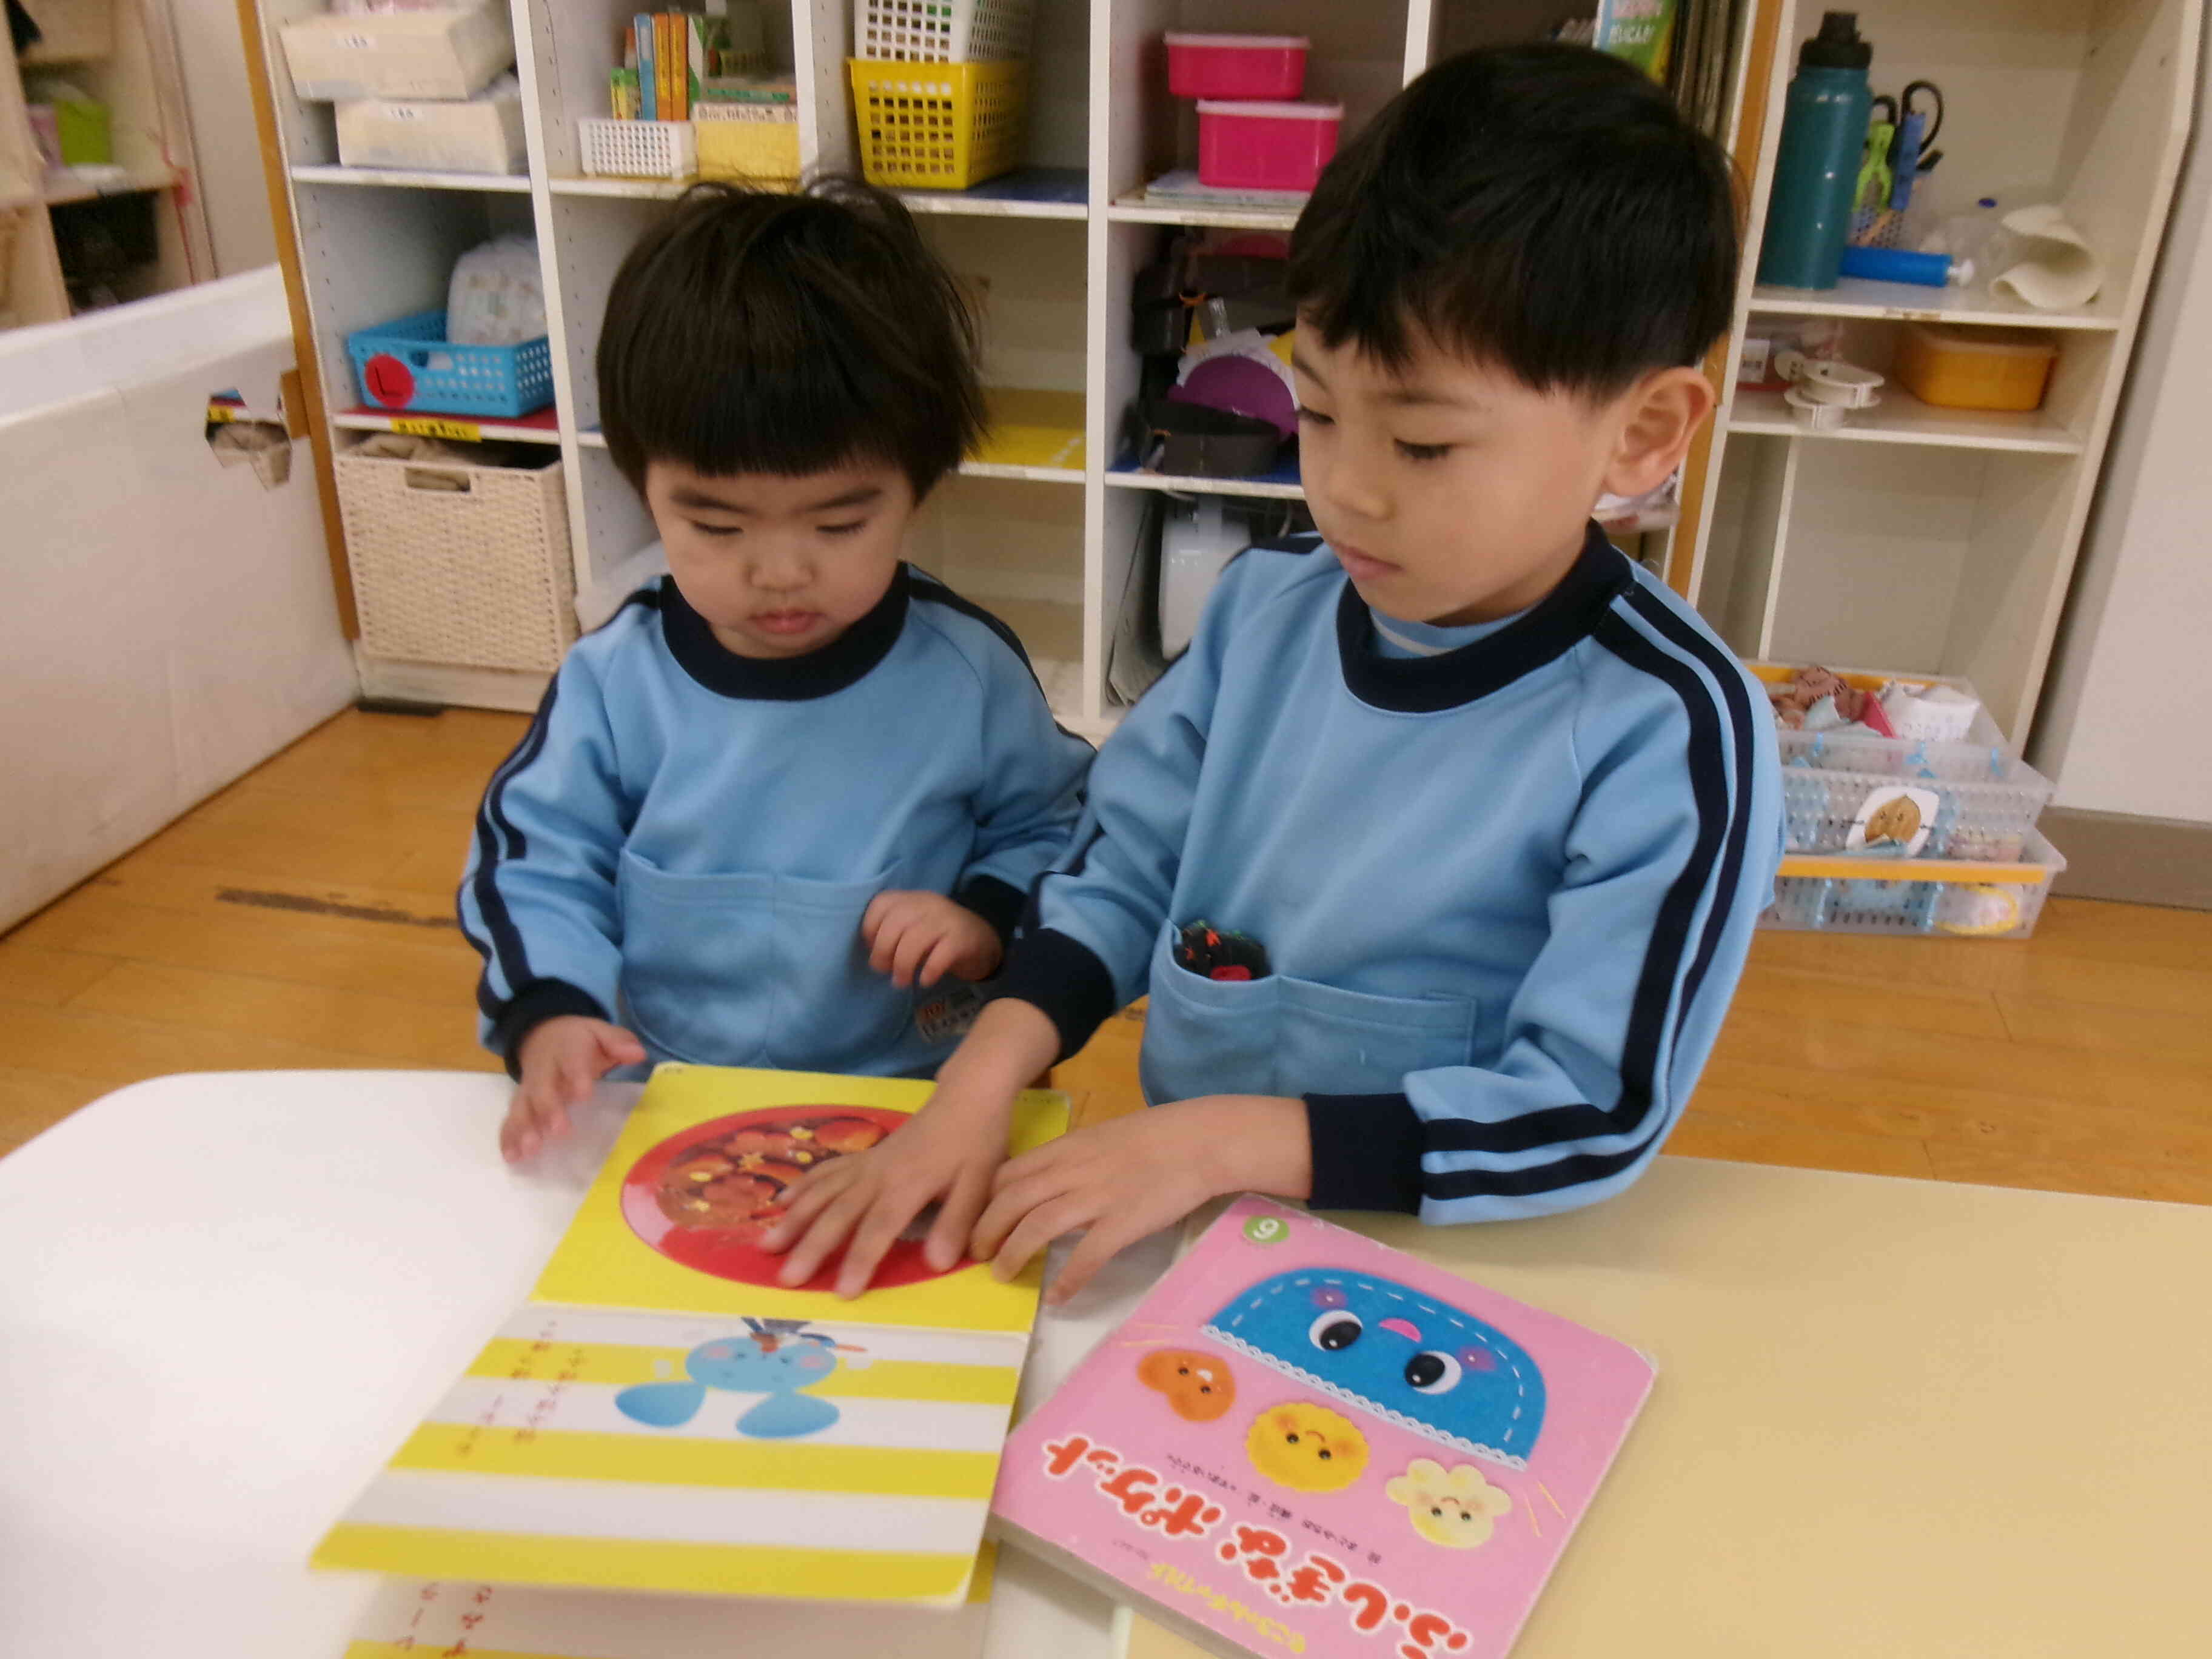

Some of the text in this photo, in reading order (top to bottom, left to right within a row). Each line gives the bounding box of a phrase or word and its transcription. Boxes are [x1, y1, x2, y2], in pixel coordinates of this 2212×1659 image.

[1253, 1218, 1279, 1239] 6
[1045, 1436, 1469, 1659] ふしぎな ポケット
